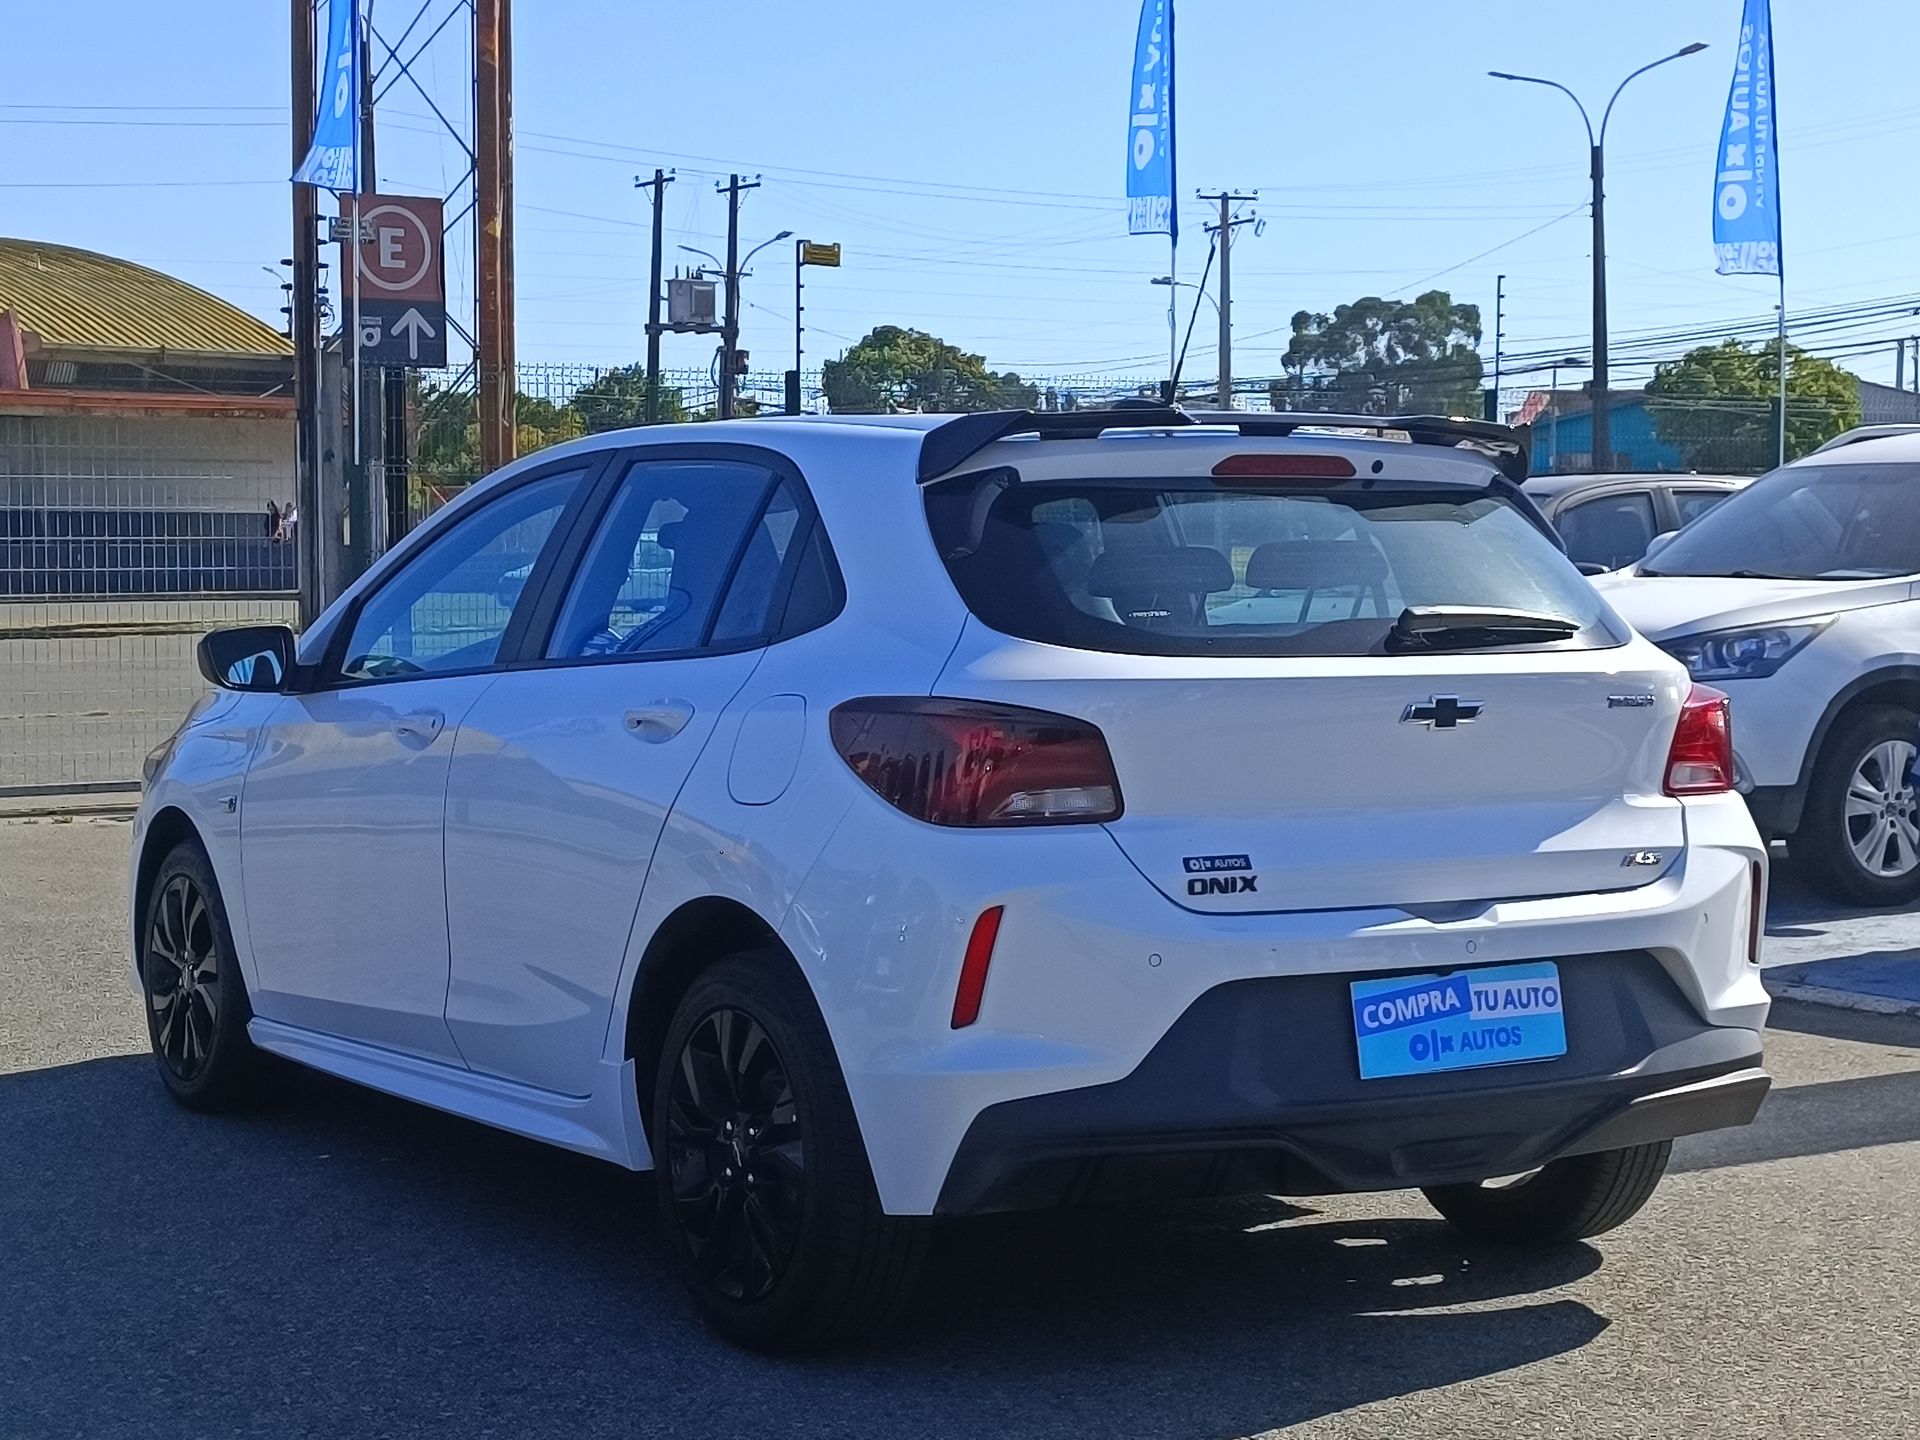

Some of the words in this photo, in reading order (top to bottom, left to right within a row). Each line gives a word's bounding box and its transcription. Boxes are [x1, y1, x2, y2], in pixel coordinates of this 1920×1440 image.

[379, 227, 406, 268] E
[1214, 858, 1247, 869] AUTOS
[1187, 875, 1258, 895] ONIX
[1362, 986, 1461, 1028] COMPRA
[1473, 989, 1498, 1012] TU
[1502, 985, 1559, 1010] AUTO
[1459, 1025, 1523, 1053] AUTOS
